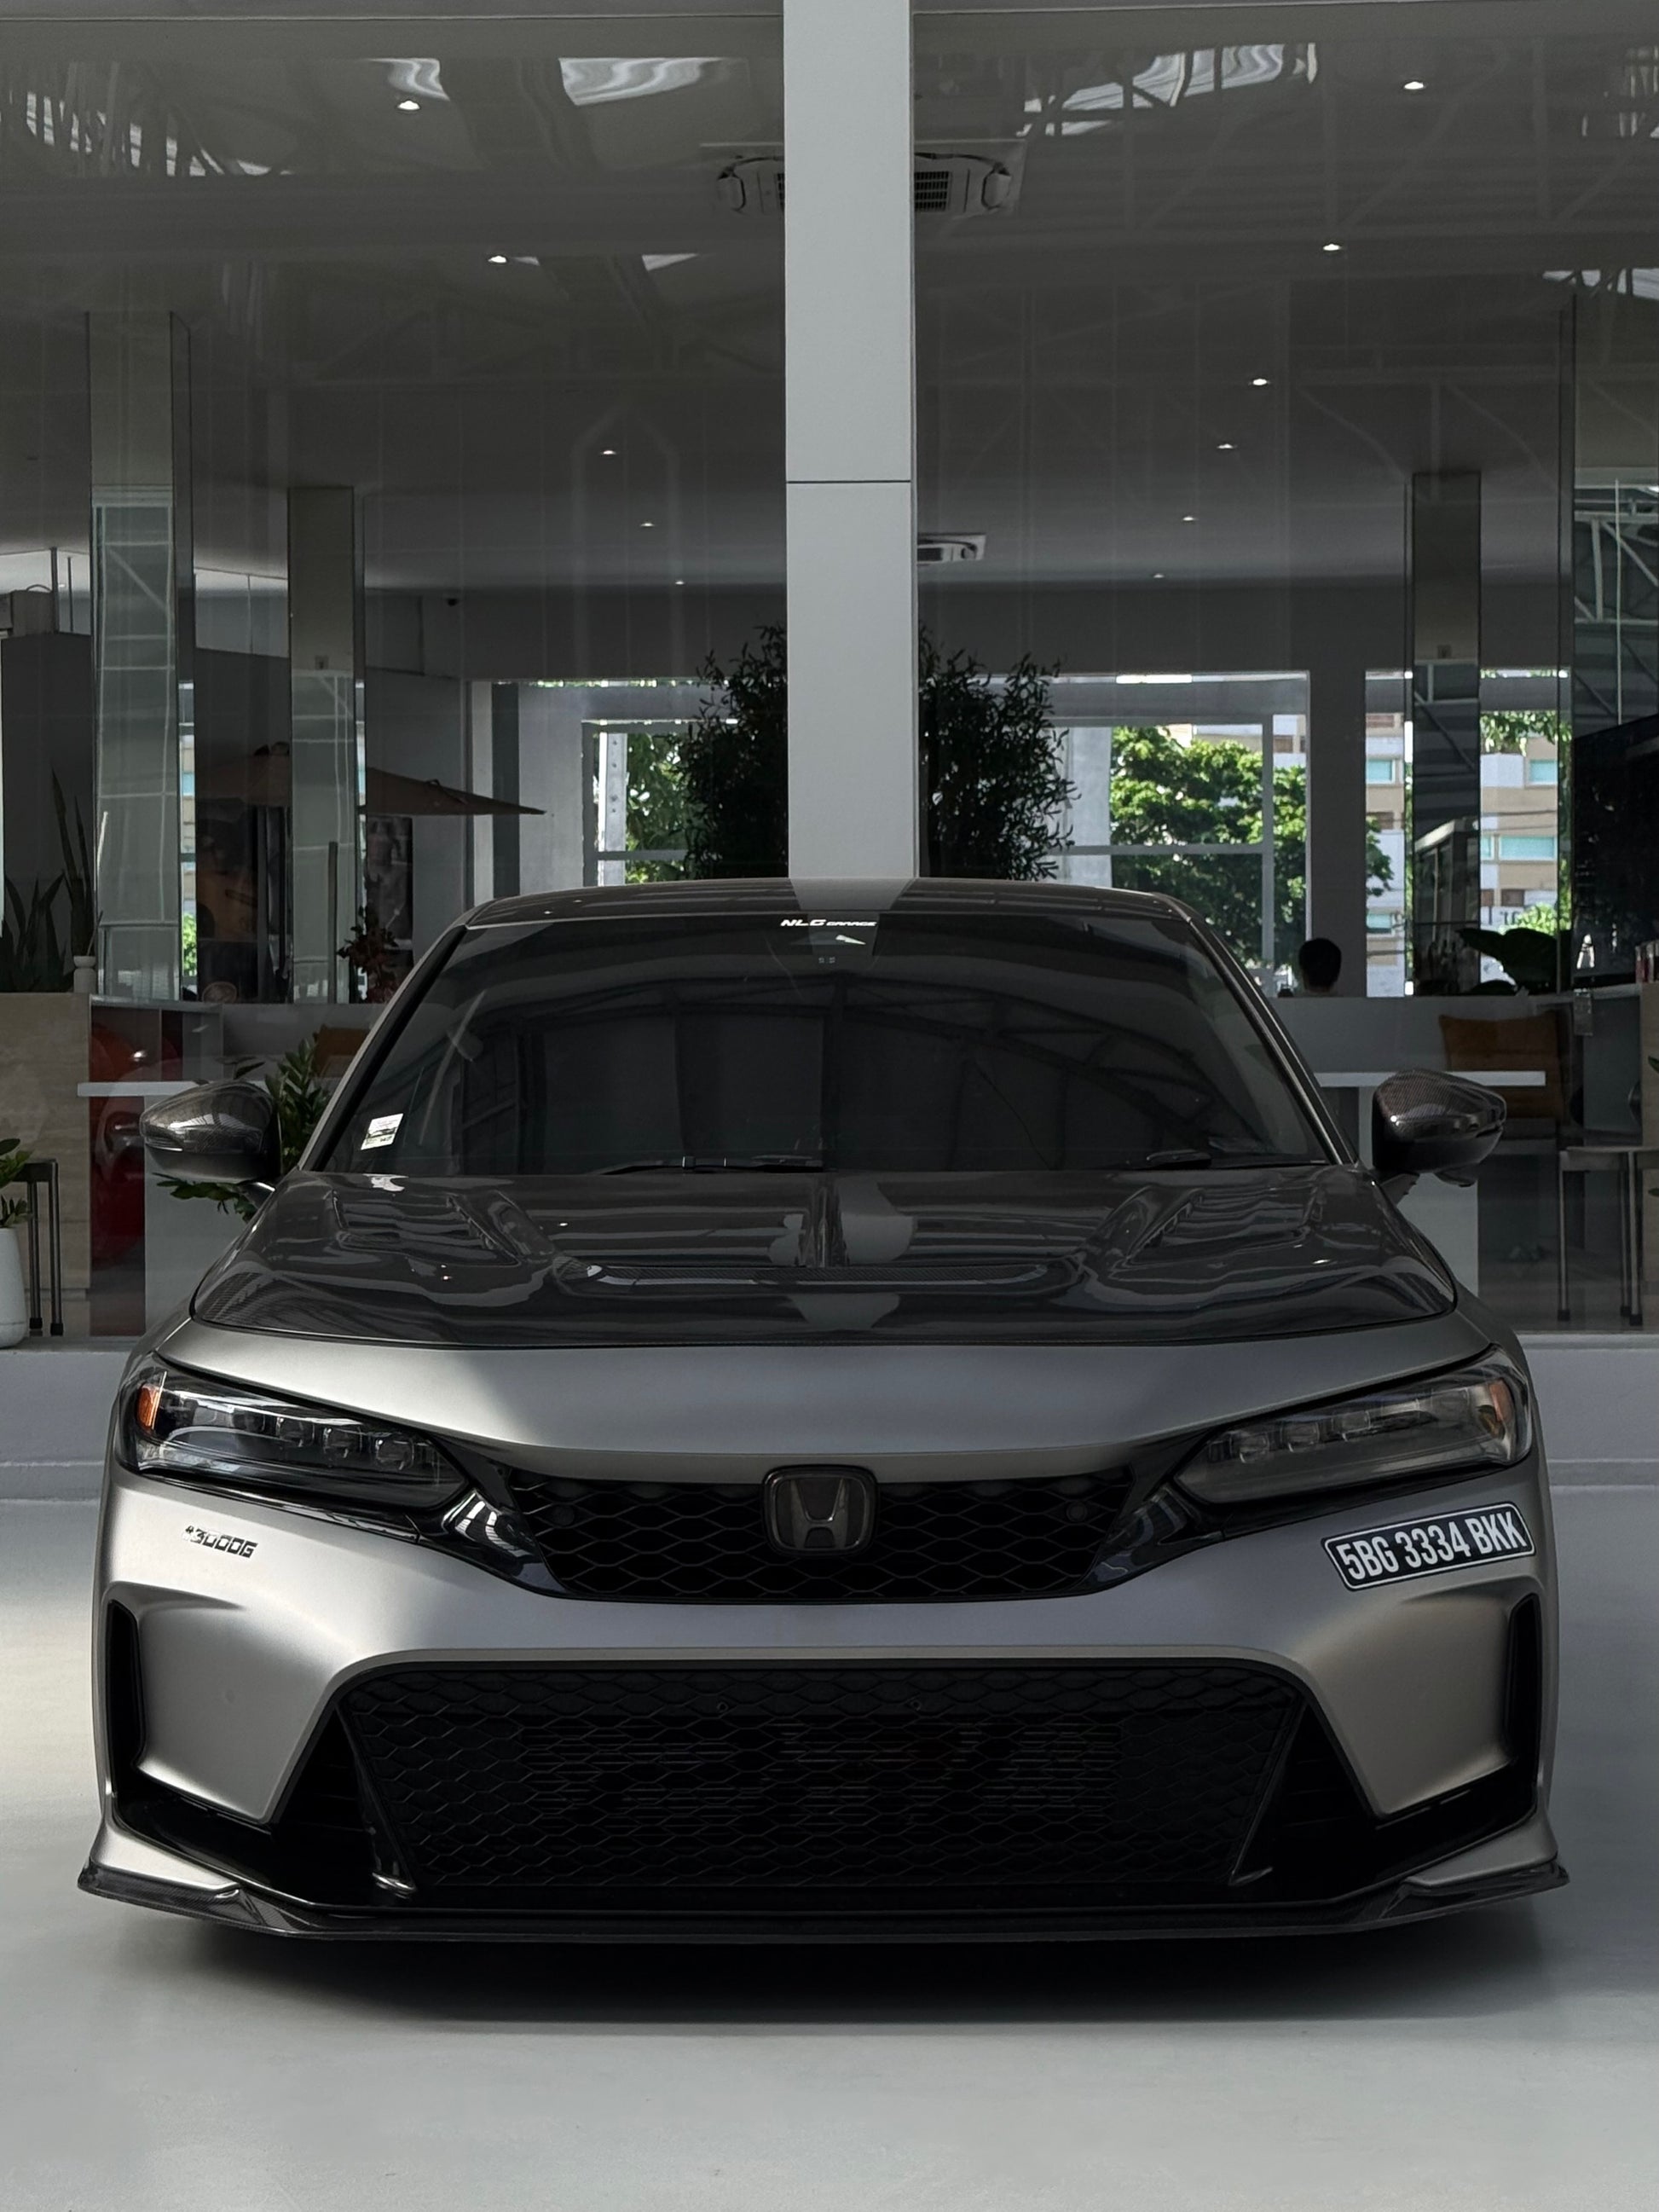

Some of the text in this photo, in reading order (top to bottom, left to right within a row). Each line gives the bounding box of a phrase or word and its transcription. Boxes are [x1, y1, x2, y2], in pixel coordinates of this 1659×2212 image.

[780, 918, 827, 927] NLG
[1336, 1510, 1528, 1580] 5BG 3334 BKK
